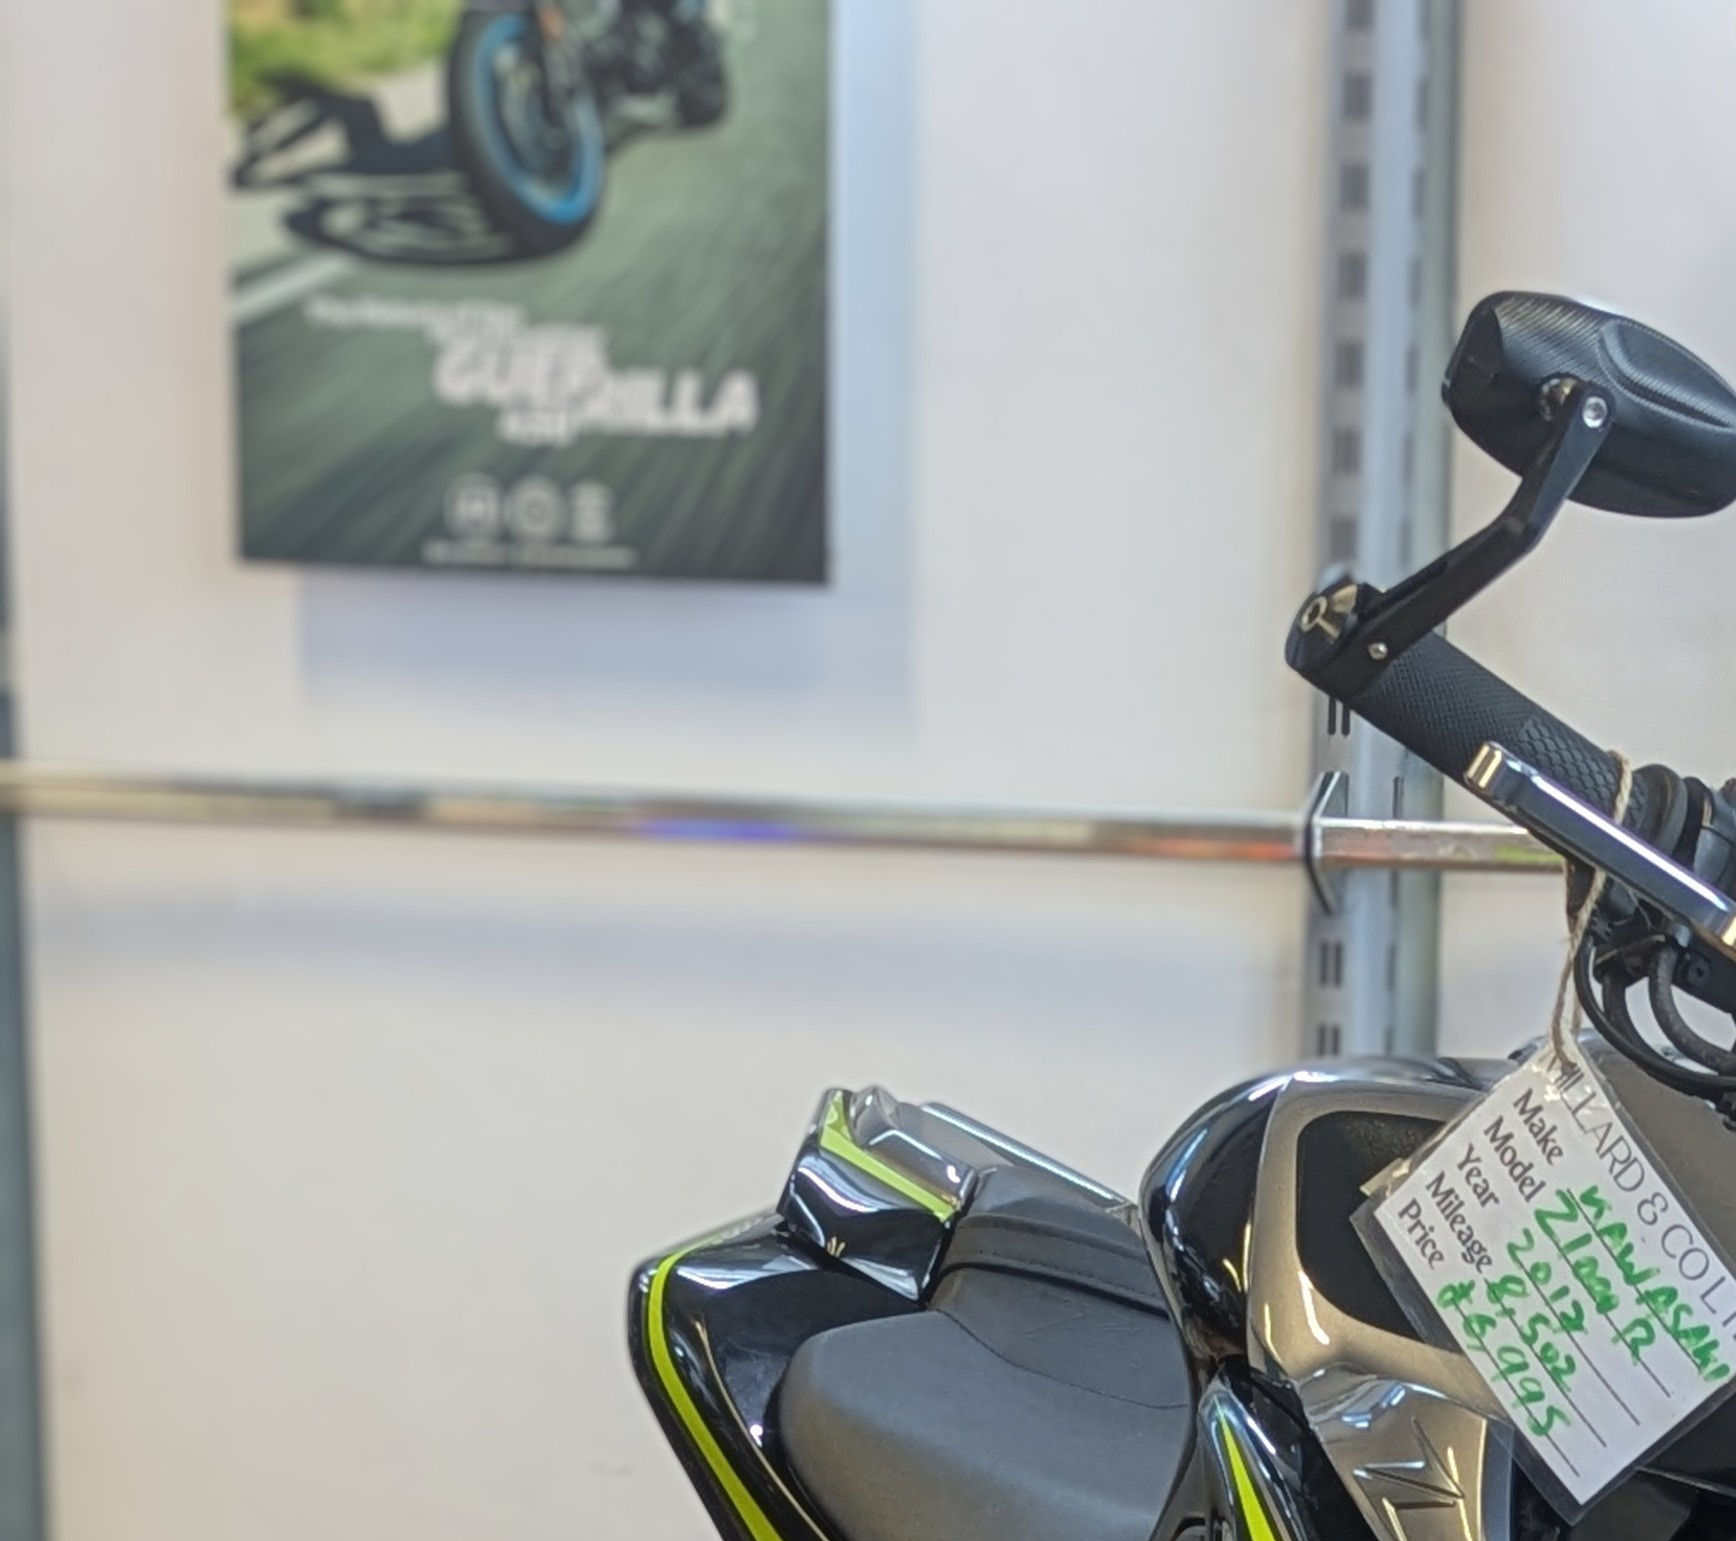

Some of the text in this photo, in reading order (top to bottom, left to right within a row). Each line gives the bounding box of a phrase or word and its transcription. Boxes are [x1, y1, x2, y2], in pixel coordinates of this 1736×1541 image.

[1484, 1115, 1546, 1202] Model
[1513, 1088, 1563, 1165] Make
[1457, 1143, 1499, 1208] Year
[1399, 1198, 1444, 1270] Price
[1426, 1171, 1492, 1273] Mileage
[1637, 1192, 1669, 1225] &
[1661, 1224, 1709, 1280] CO
